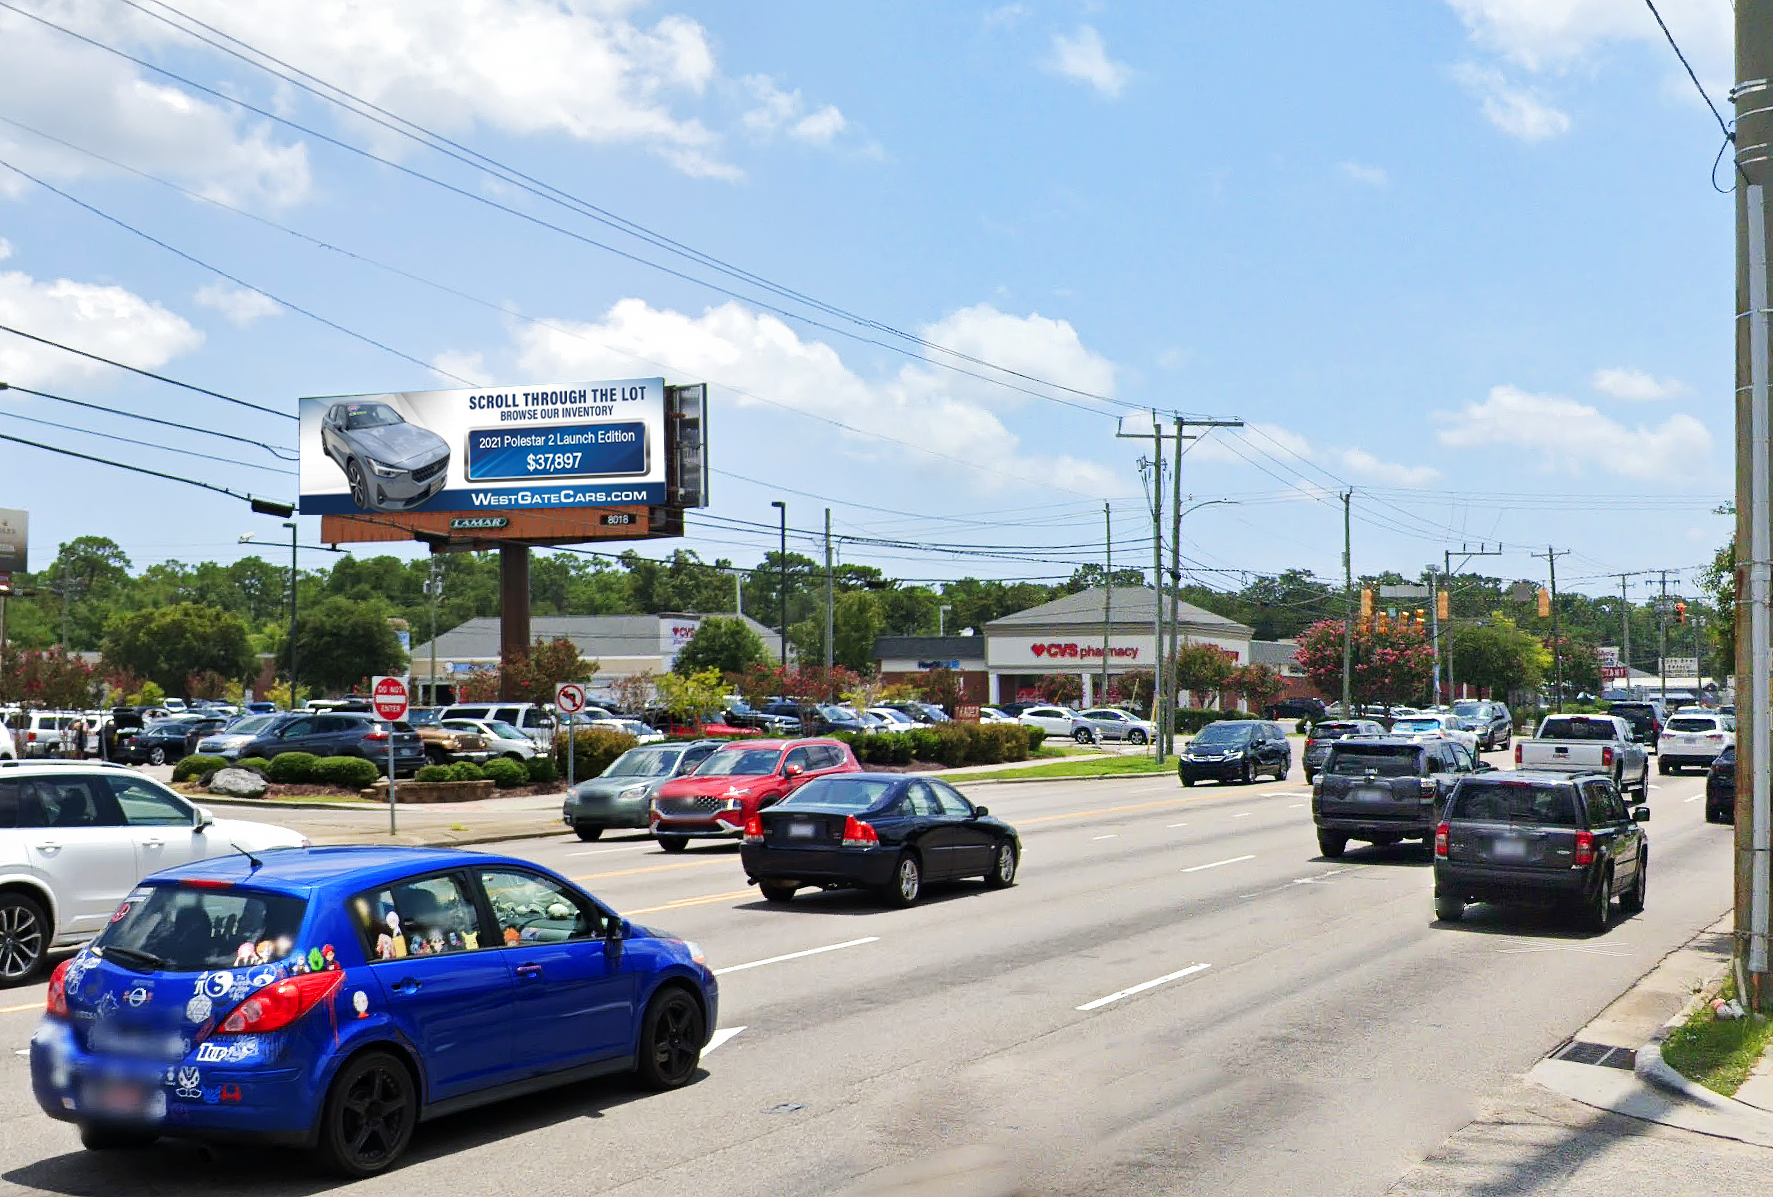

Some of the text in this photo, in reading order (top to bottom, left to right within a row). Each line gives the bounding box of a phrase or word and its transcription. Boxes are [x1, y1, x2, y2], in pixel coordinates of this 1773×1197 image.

[469, 386, 647, 410] SCROLL THROUGH THE LOT
[500, 405, 614, 421] BROWSE OUR INVENTORY
[479, 430, 635, 449] 2021 Polestar 2 Launch Edition
[527, 452, 582, 472] $37,897
[454, 517, 502, 528] LAMAR
[607, 514, 629, 525] 8018
[1046, 643, 1078, 658] CVS
[378, 685, 404, 694] DO NOT
[380, 704, 401, 712] ENTER
